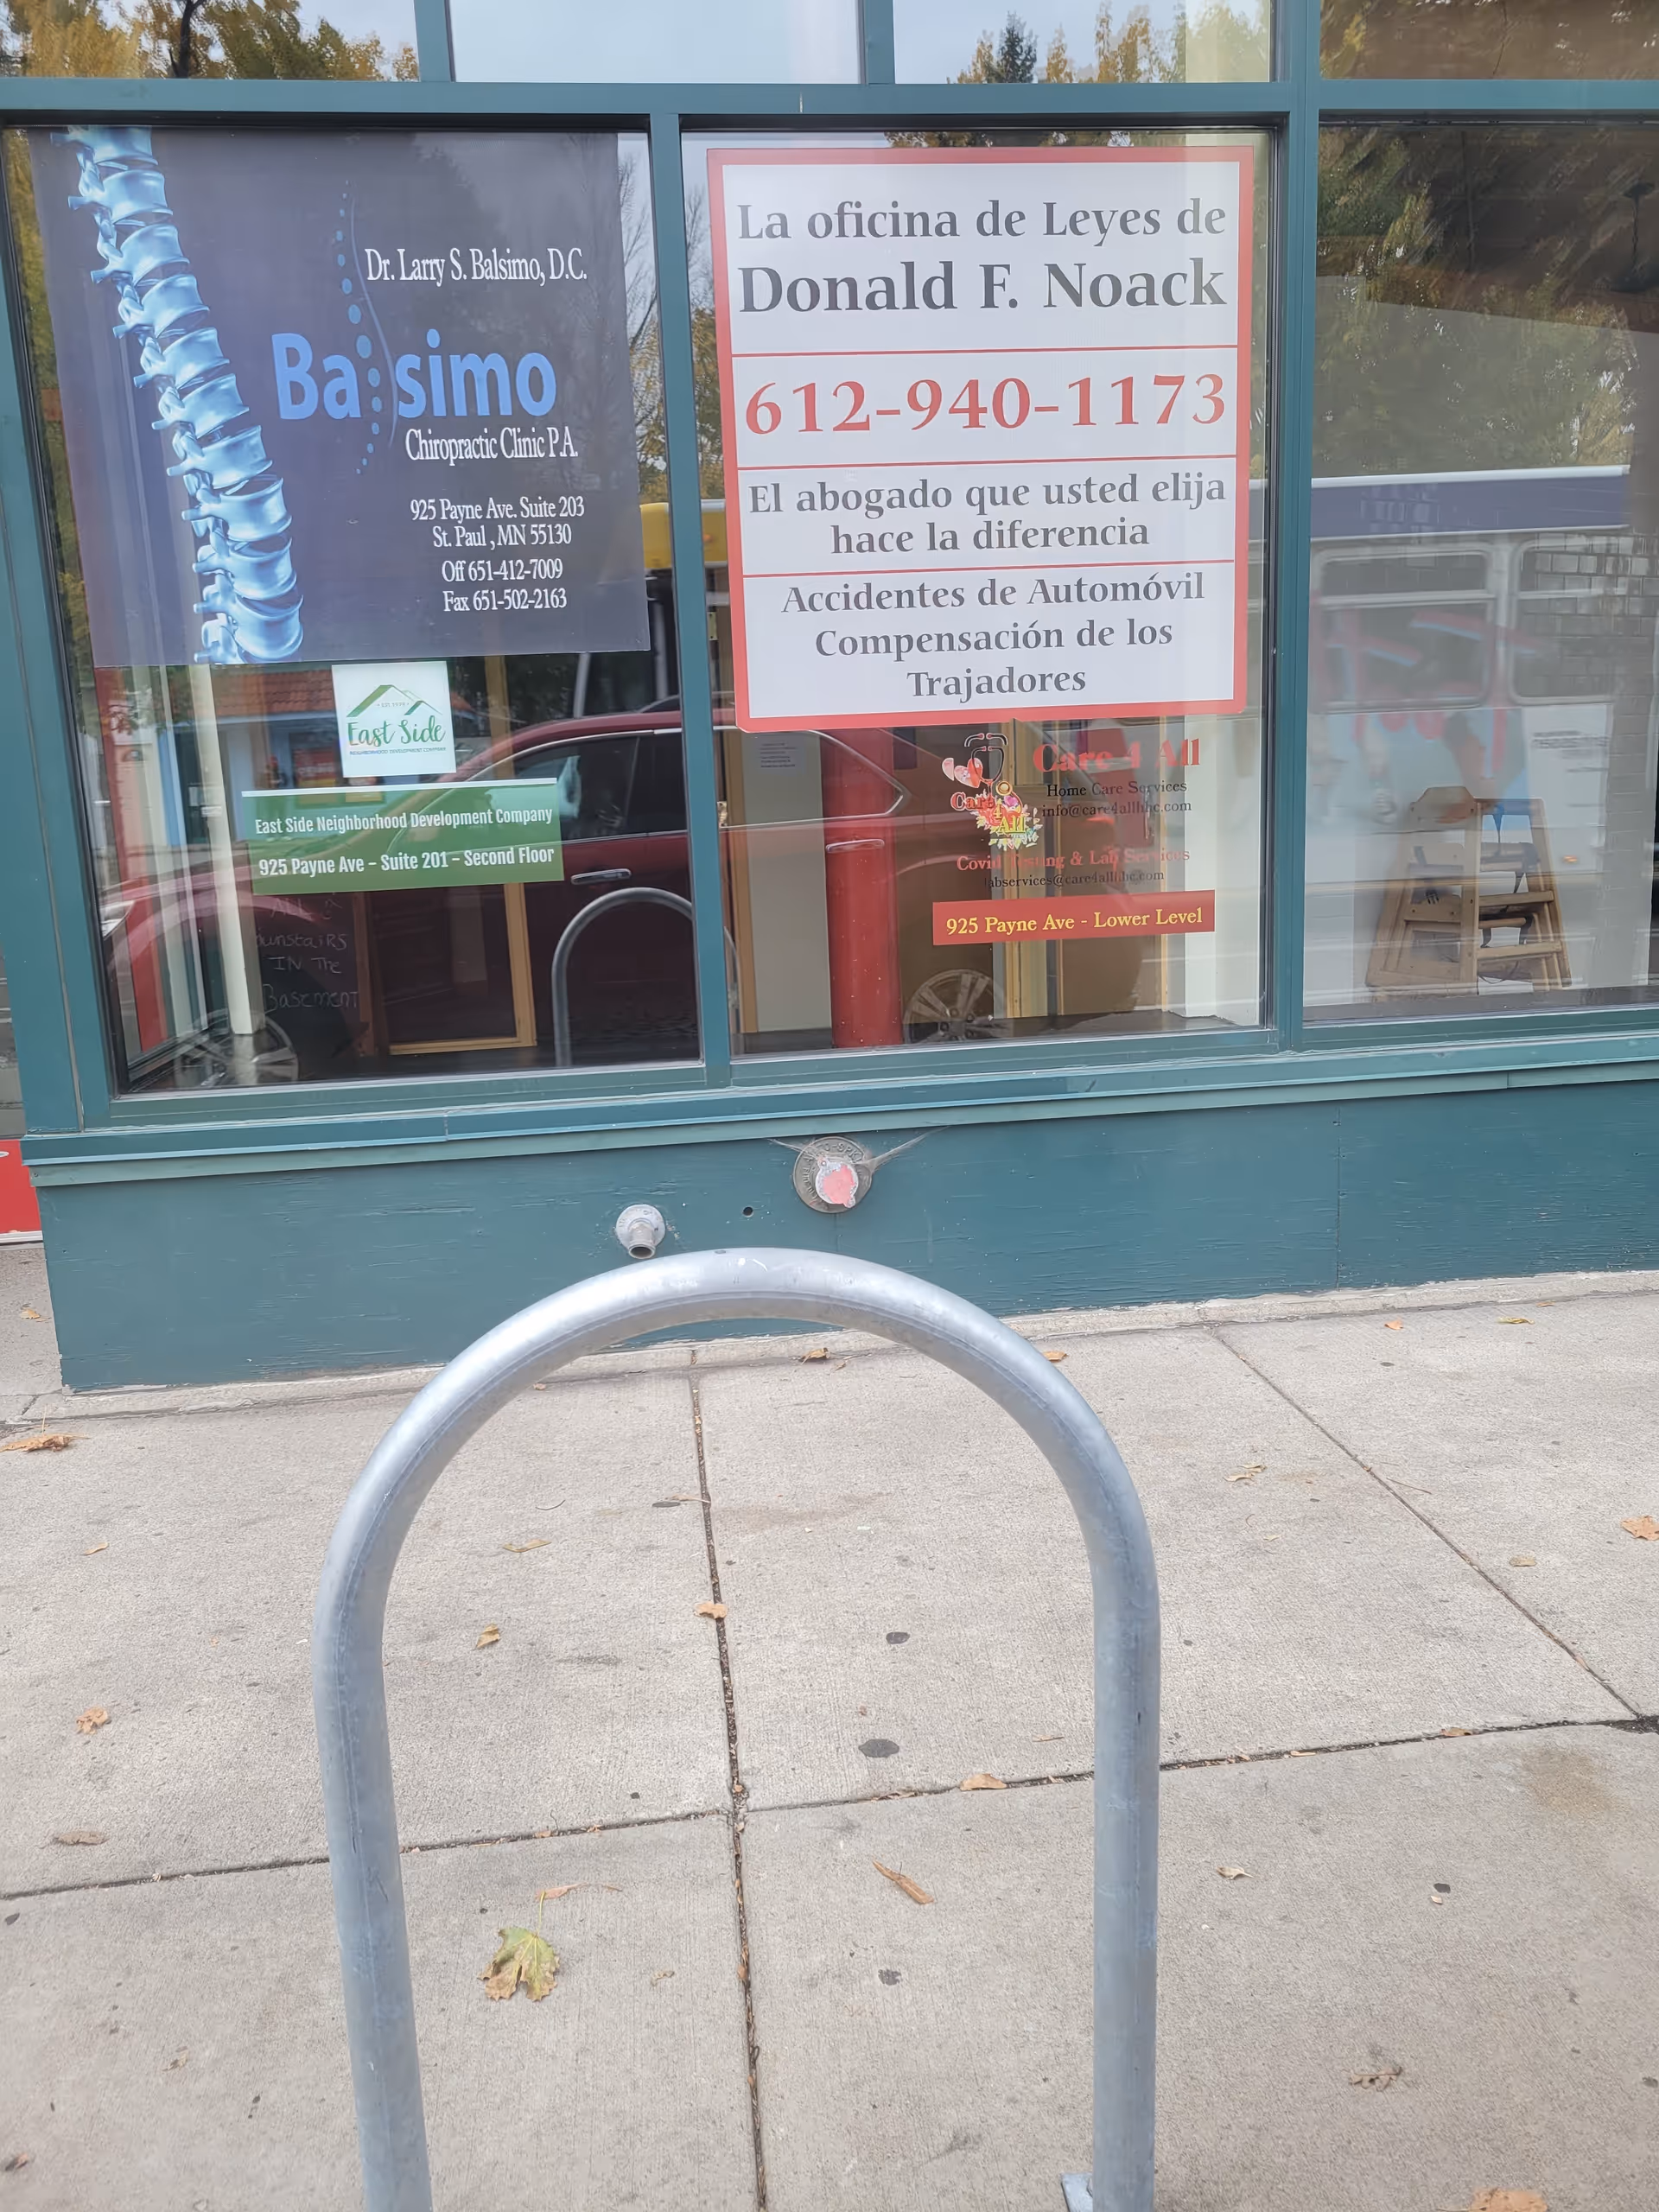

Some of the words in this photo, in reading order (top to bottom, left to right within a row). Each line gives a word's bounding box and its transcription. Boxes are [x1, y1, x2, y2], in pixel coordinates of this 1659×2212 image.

[737, 204, 791, 239] La
[807, 200, 960, 239] oficina
[976, 200, 1026, 237] de
[1042, 201, 1160, 247] Leyes
[1177, 198, 1225, 234] de
[365, 248, 395, 281] Dr.
[397, 248, 445, 287] Larry
[449, 247, 467, 281] S.
[469, 247, 546, 287] Balsimo,
[547, 247, 588, 280] D.C.
[738, 260, 958, 313] Donald
[979, 264, 1019, 308] F.
[1043, 257, 1228, 308] Noack
[745, 373, 1225, 435] 612-940-1173
[404, 428, 499, 466] Chiropractic
[499, 427, 545, 459] Clinic
[547, 426, 579, 457] P.A.
[410, 499, 436, 520] 925
[439, 498, 482, 524] Payne
[486, 497, 518, 518] Ave.
[519, 496, 556, 518] Suite
[558, 495, 585, 518] 203
[748, 482, 784, 513] El
[796, 479, 952, 519] abogado
[965, 484, 1030, 517] que
[1042, 473, 1139, 505] usted
[1151, 472, 1226, 510] elija
[432, 525, 452, 548] St.
[454, 524, 487, 547] Paul
[531, 524, 572, 545] 55130
[830, 524, 913, 555] hace
[926, 522, 960, 550] la
[972, 517, 1149, 550] diferencia
[442, 560, 467, 582] Off
[467, 557, 563, 582] 651-412-7009
[442, 590, 471, 612] Fax
[473, 588, 568, 611] 651-502-2163
[781, 582, 965, 613] Accidentes
[977, 577, 1017, 606] de
[1027, 571, 1205, 605] Automóvil
[815, 619, 1065, 662] Compensación
[1076, 620, 1115, 648] de
[1126, 618, 1173, 646] los
[906, 665, 1087, 704] Trajadores
[347, 720, 396, 747] East
[397, 715, 446, 745] Side
[1033, 743, 1114, 772] Care
[1125, 741, 1142, 769] 4
[1155, 738, 1201, 768] All
[950, 791, 995, 811] Care
[1046, 784, 1087, 798] Home
[1091, 782, 1123, 796] Care
[1128, 779, 1188, 794] Services
[255, 819, 283, 835] East
[286, 817, 314, 833] Side
[316, 812, 407, 835] Neighborhood
[410, 809, 493, 830] Development
[495, 808, 553, 825] Company
[997, 816, 1027, 834] All
[259, 858, 288, 876] 925
[291, 858, 335, 878] Payne
[339, 855, 365, 874] Ave
[380, 852, 419, 871] Suite
[422, 851, 449, 869] 201
[463, 847, 515, 867] Second
[518, 846, 555, 864] Floor
[957, 855, 1002, 871] Covid
[1070, 851, 1084, 866] &
[1089, 849, 1119, 865] Lab
[946, 917, 978, 936] 925
[984, 916, 1037, 936] Payne
[1042, 914, 1075, 931] Ave
[1094, 912, 1150, 928] Lower
[1155, 907, 1203, 925] Level
